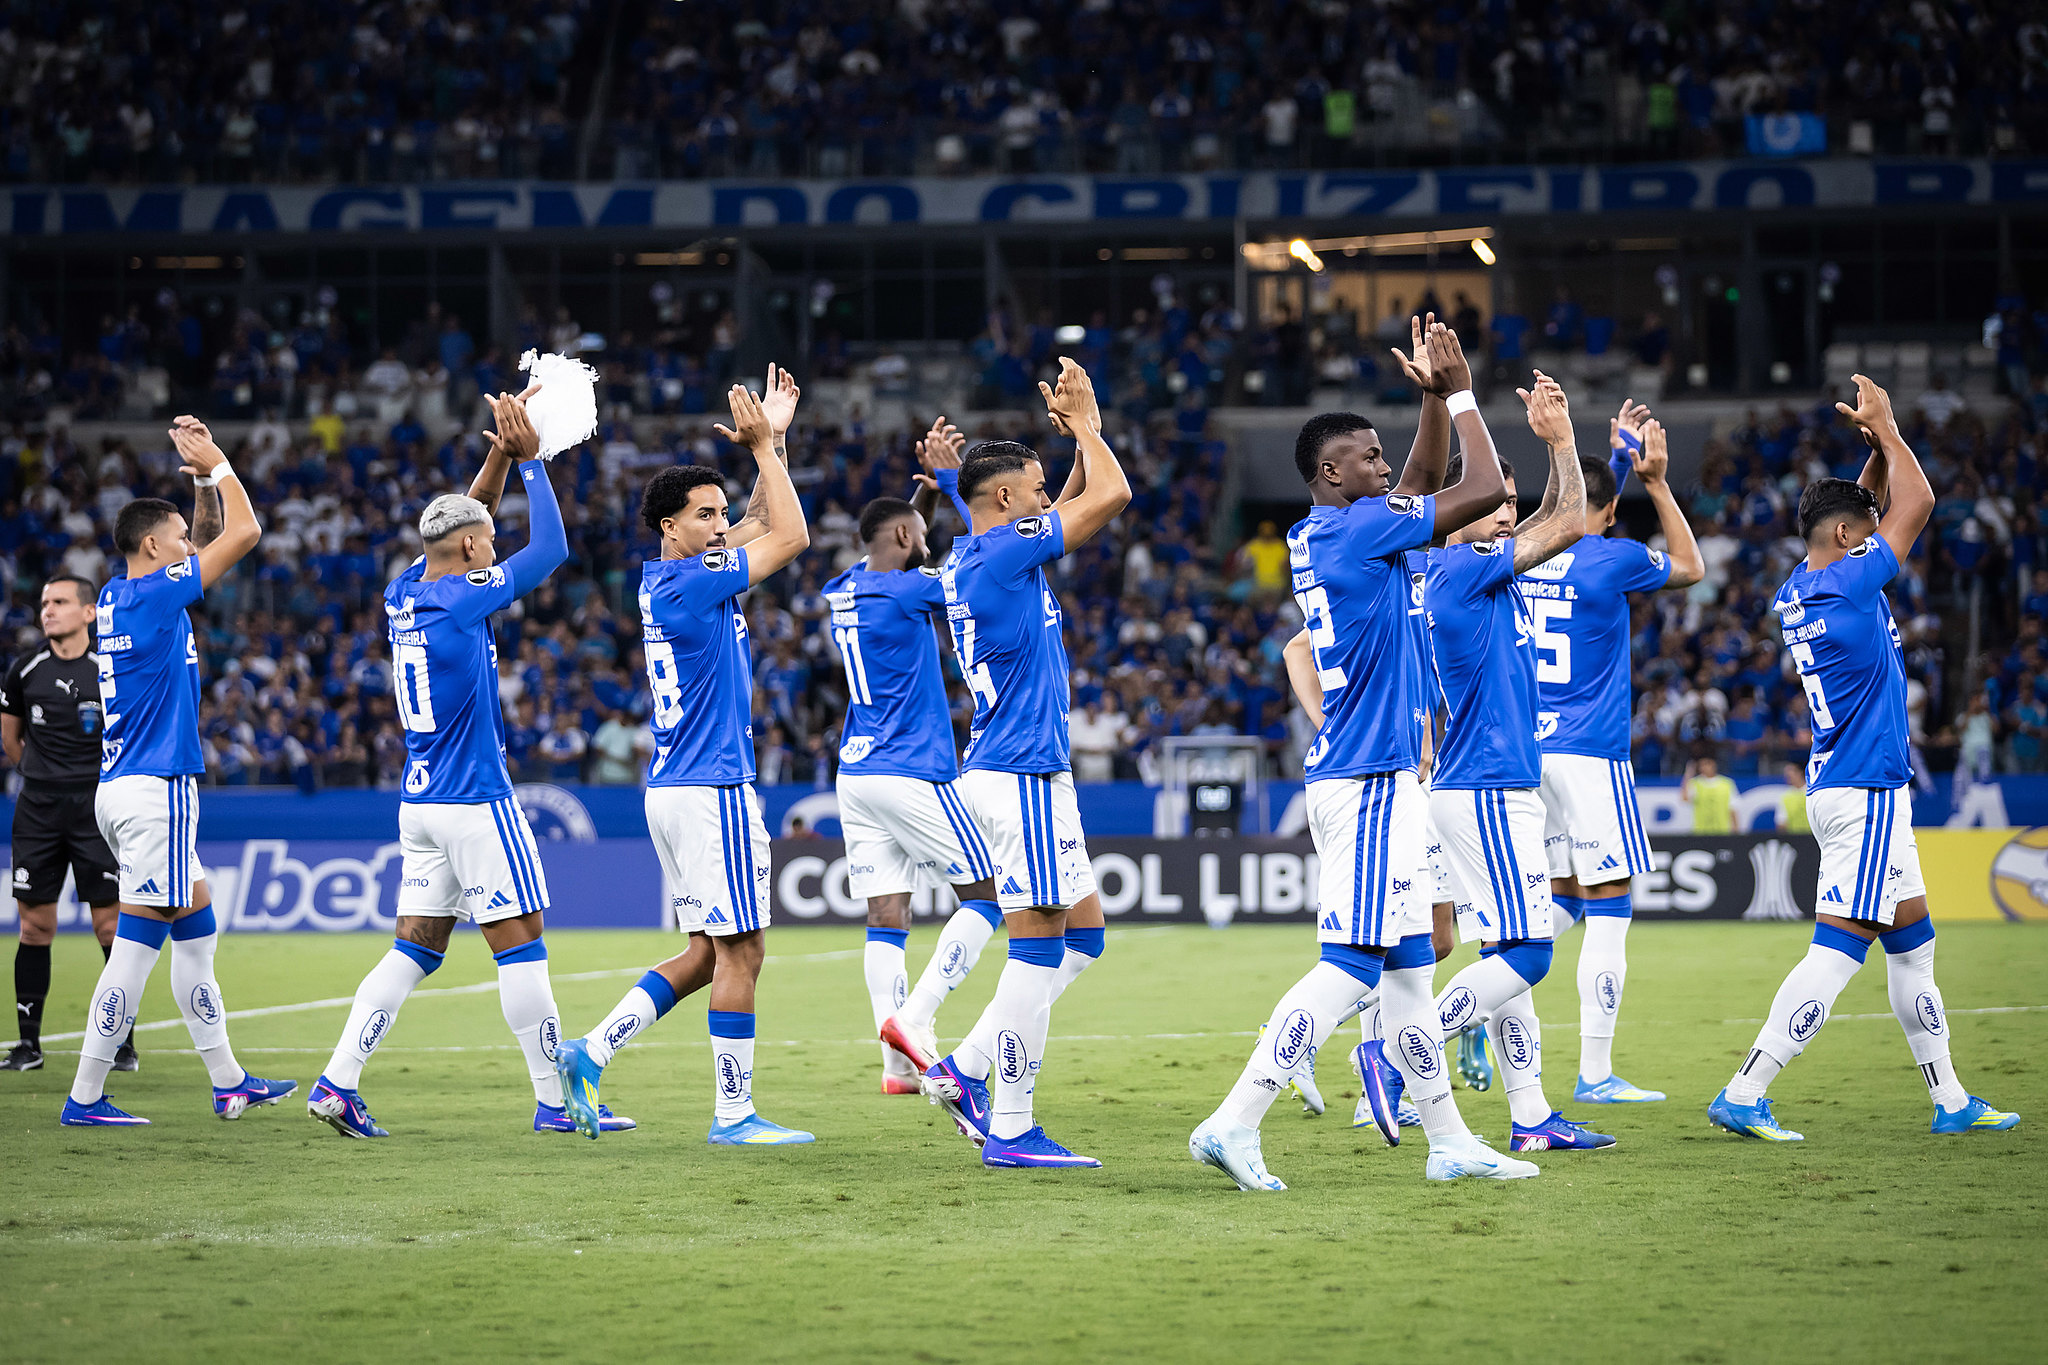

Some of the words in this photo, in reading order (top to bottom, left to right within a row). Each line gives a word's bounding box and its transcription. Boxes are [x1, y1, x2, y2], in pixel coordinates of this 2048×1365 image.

[12, 188, 655, 233] IMAGEM
[711, 184, 920, 226] DO
[979, 164, 1816, 222] CRUZEIRO
[1516, 580, 1561, 598] BRÍCIO
[835, 627, 873, 706] 11
[393, 643, 437, 733] 10
[943, 944, 961, 976] Kodilar
[101, 990, 120, 1032] Kodilar
[199, 986, 218, 1020] Kodilar
[1440, 990, 1471, 1027] Kodilar
[1604, 975, 1616, 1010] Kodilar
[363, 1011, 387, 1050] Kodilar
[1793, 1003, 1822, 1038] Kodilar
[1922, 995, 1941, 1031] Kodilar
[606, 1017, 636, 1049] Kodilar
[1279, 1013, 1309, 1064] Kodilar
[1511, 1020, 1528, 1064] Kodilar
[1003, 1033, 1019, 1079] Kodilar
[1405, 1031, 1437, 1074] Kodilar
[721, 1056, 738, 1094] Kodilar
